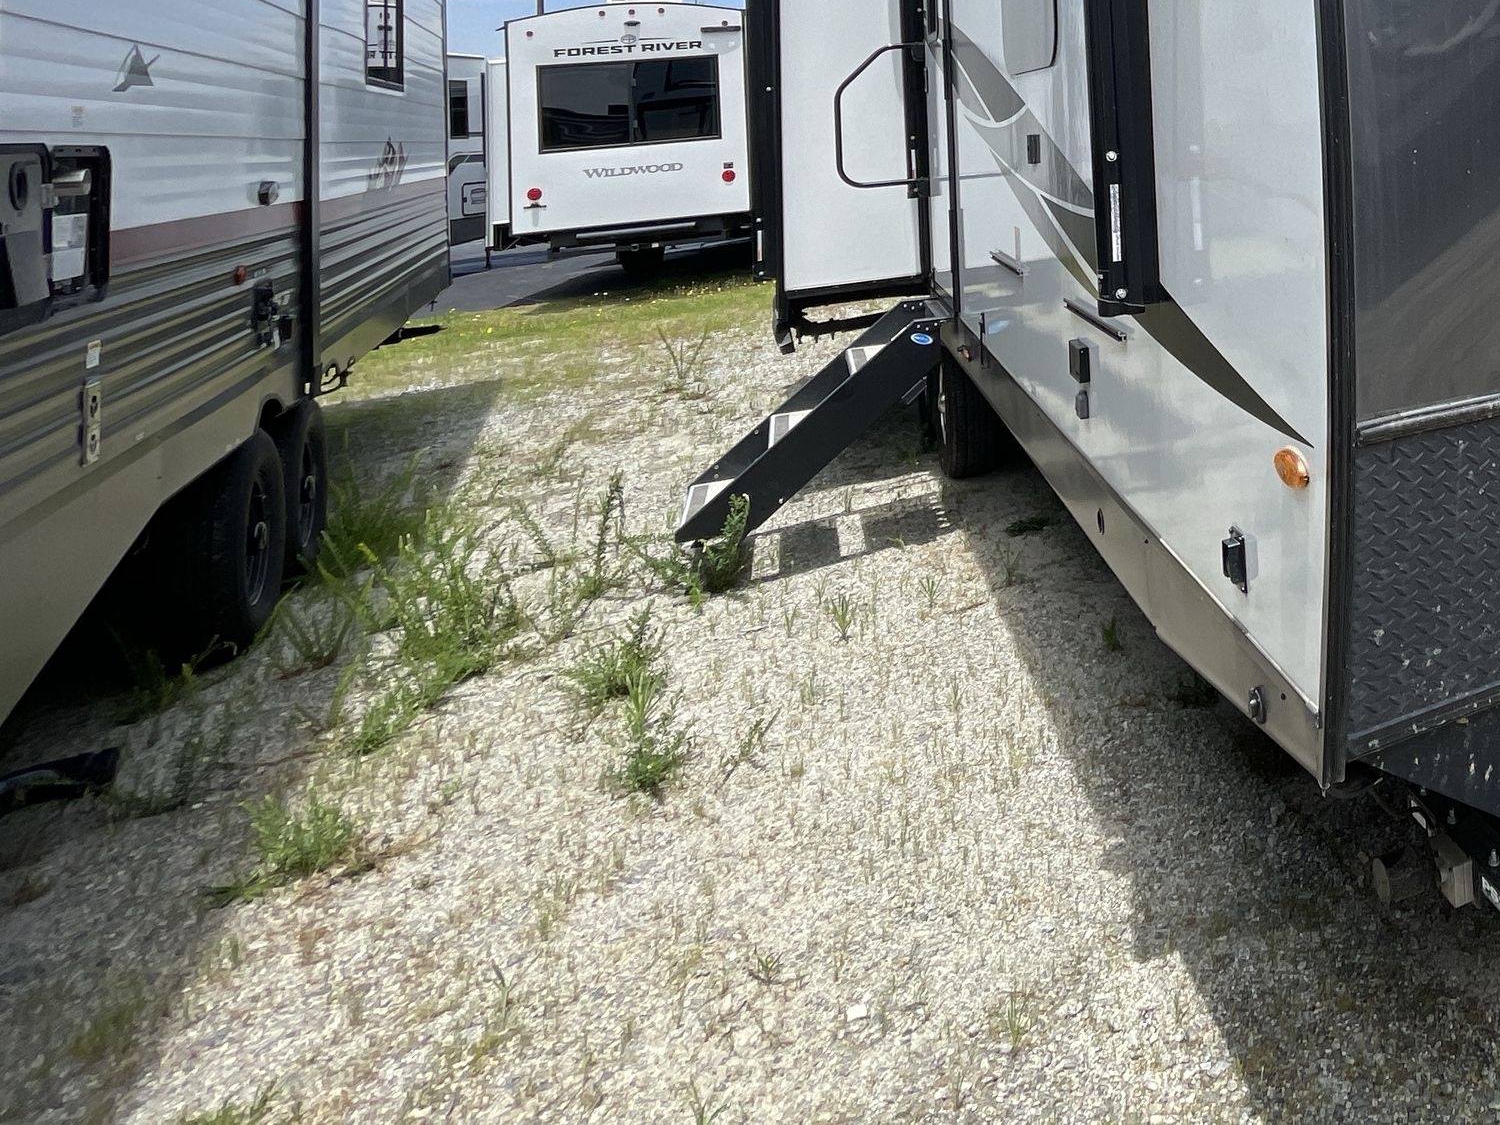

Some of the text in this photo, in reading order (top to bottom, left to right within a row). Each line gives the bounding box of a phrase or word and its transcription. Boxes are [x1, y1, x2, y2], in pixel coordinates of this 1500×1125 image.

[553, 40, 702, 58] FOREST RIVER
[582, 162, 683, 179] WILDWOOD
